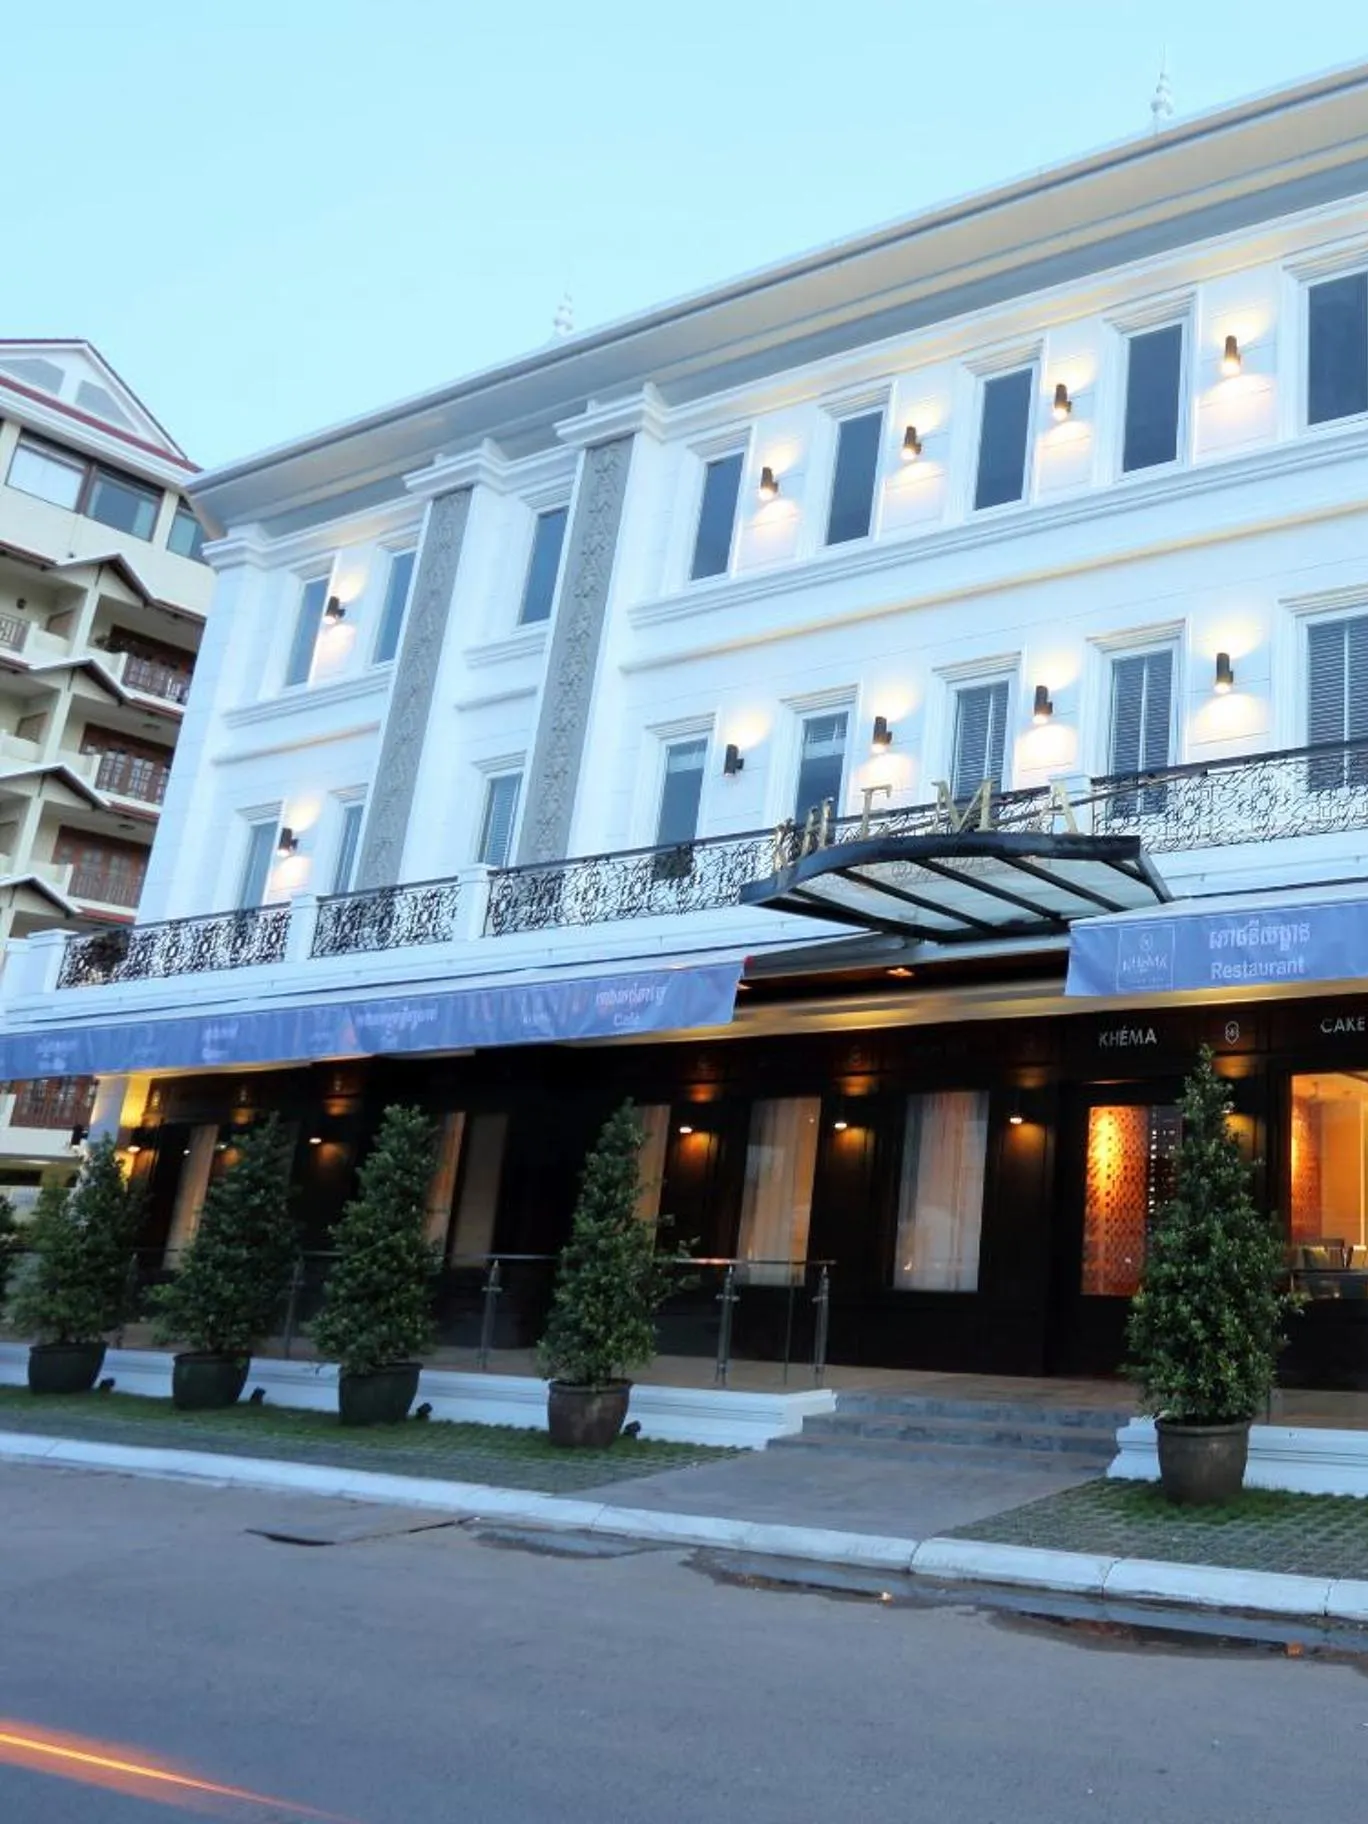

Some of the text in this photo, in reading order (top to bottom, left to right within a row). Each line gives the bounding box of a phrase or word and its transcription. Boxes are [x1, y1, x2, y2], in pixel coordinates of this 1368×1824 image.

[1211, 955, 1305, 980] Restaurant
[1098, 1025, 1158, 1048] KHÉMA
[1320, 1016, 1367, 1034] CAKE
